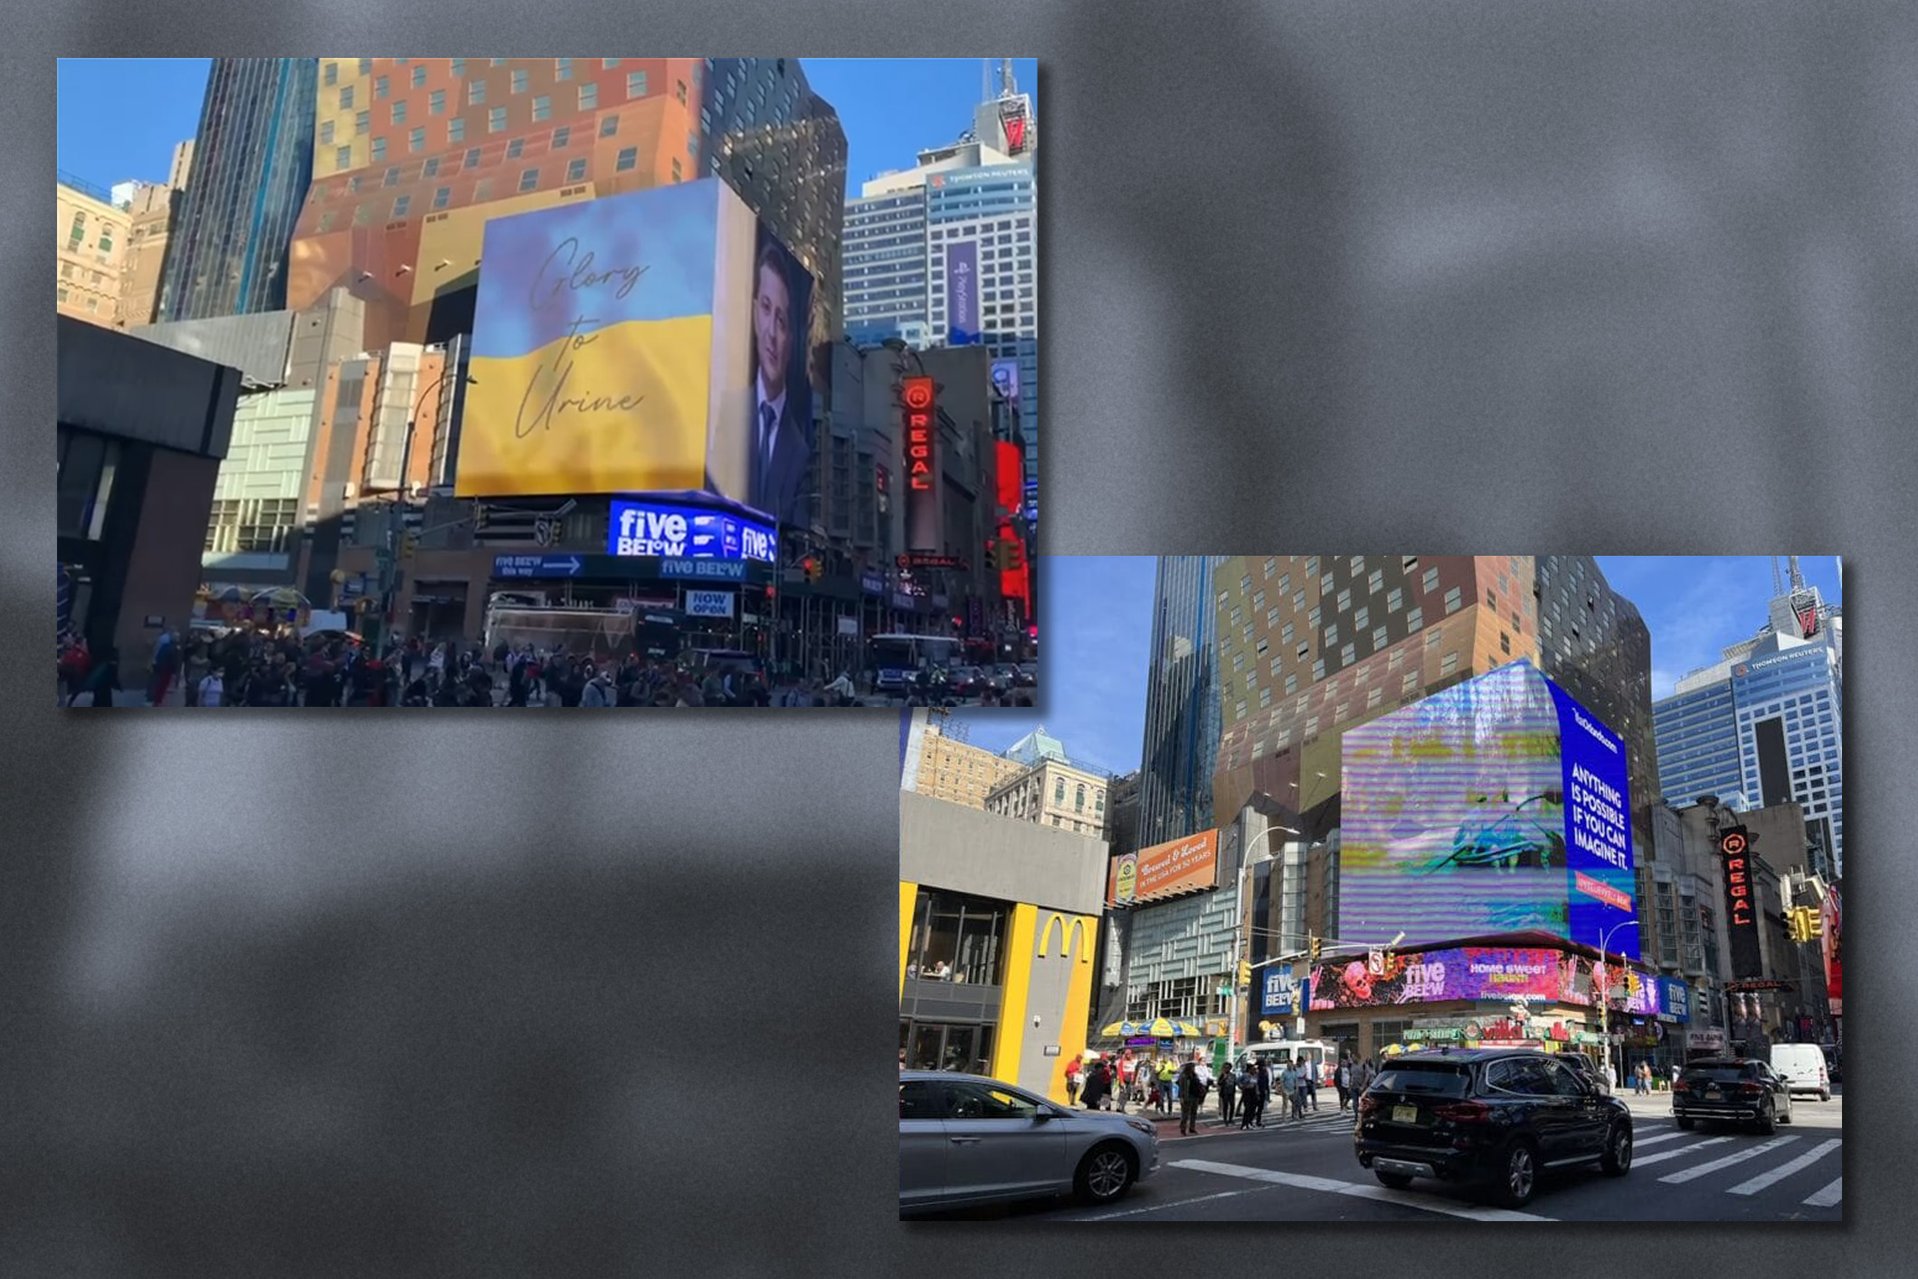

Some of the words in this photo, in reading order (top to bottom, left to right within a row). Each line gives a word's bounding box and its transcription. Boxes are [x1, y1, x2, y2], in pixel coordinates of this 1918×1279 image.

[531, 237, 650, 308] Glory
[553, 315, 600, 371] to
[515, 360, 646, 438] Urine
[910, 414, 929, 489] REGAL
[617, 537, 686, 556] BELOW
[620, 509, 687, 542] five
[742, 527, 768, 558] five
[662, 560, 693, 574] five
[696, 561, 745, 577] BELOW
[693, 592, 727, 604] NOW
[1571, 762, 1622, 809] ANYTHING
[1571, 781, 1582, 803] IS
[1582, 789, 1625, 831] POSSIBLE
[1573, 804, 1583, 825] IF
[1583, 810, 1605, 838] YOU
[1606, 825, 1627, 850] CAN
[1574, 827, 1617, 865] IMAGINE
[1728, 858, 1751, 925] REGAL
[1405, 962, 1446, 985] five
[1406, 982, 1446, 997] BELOW
